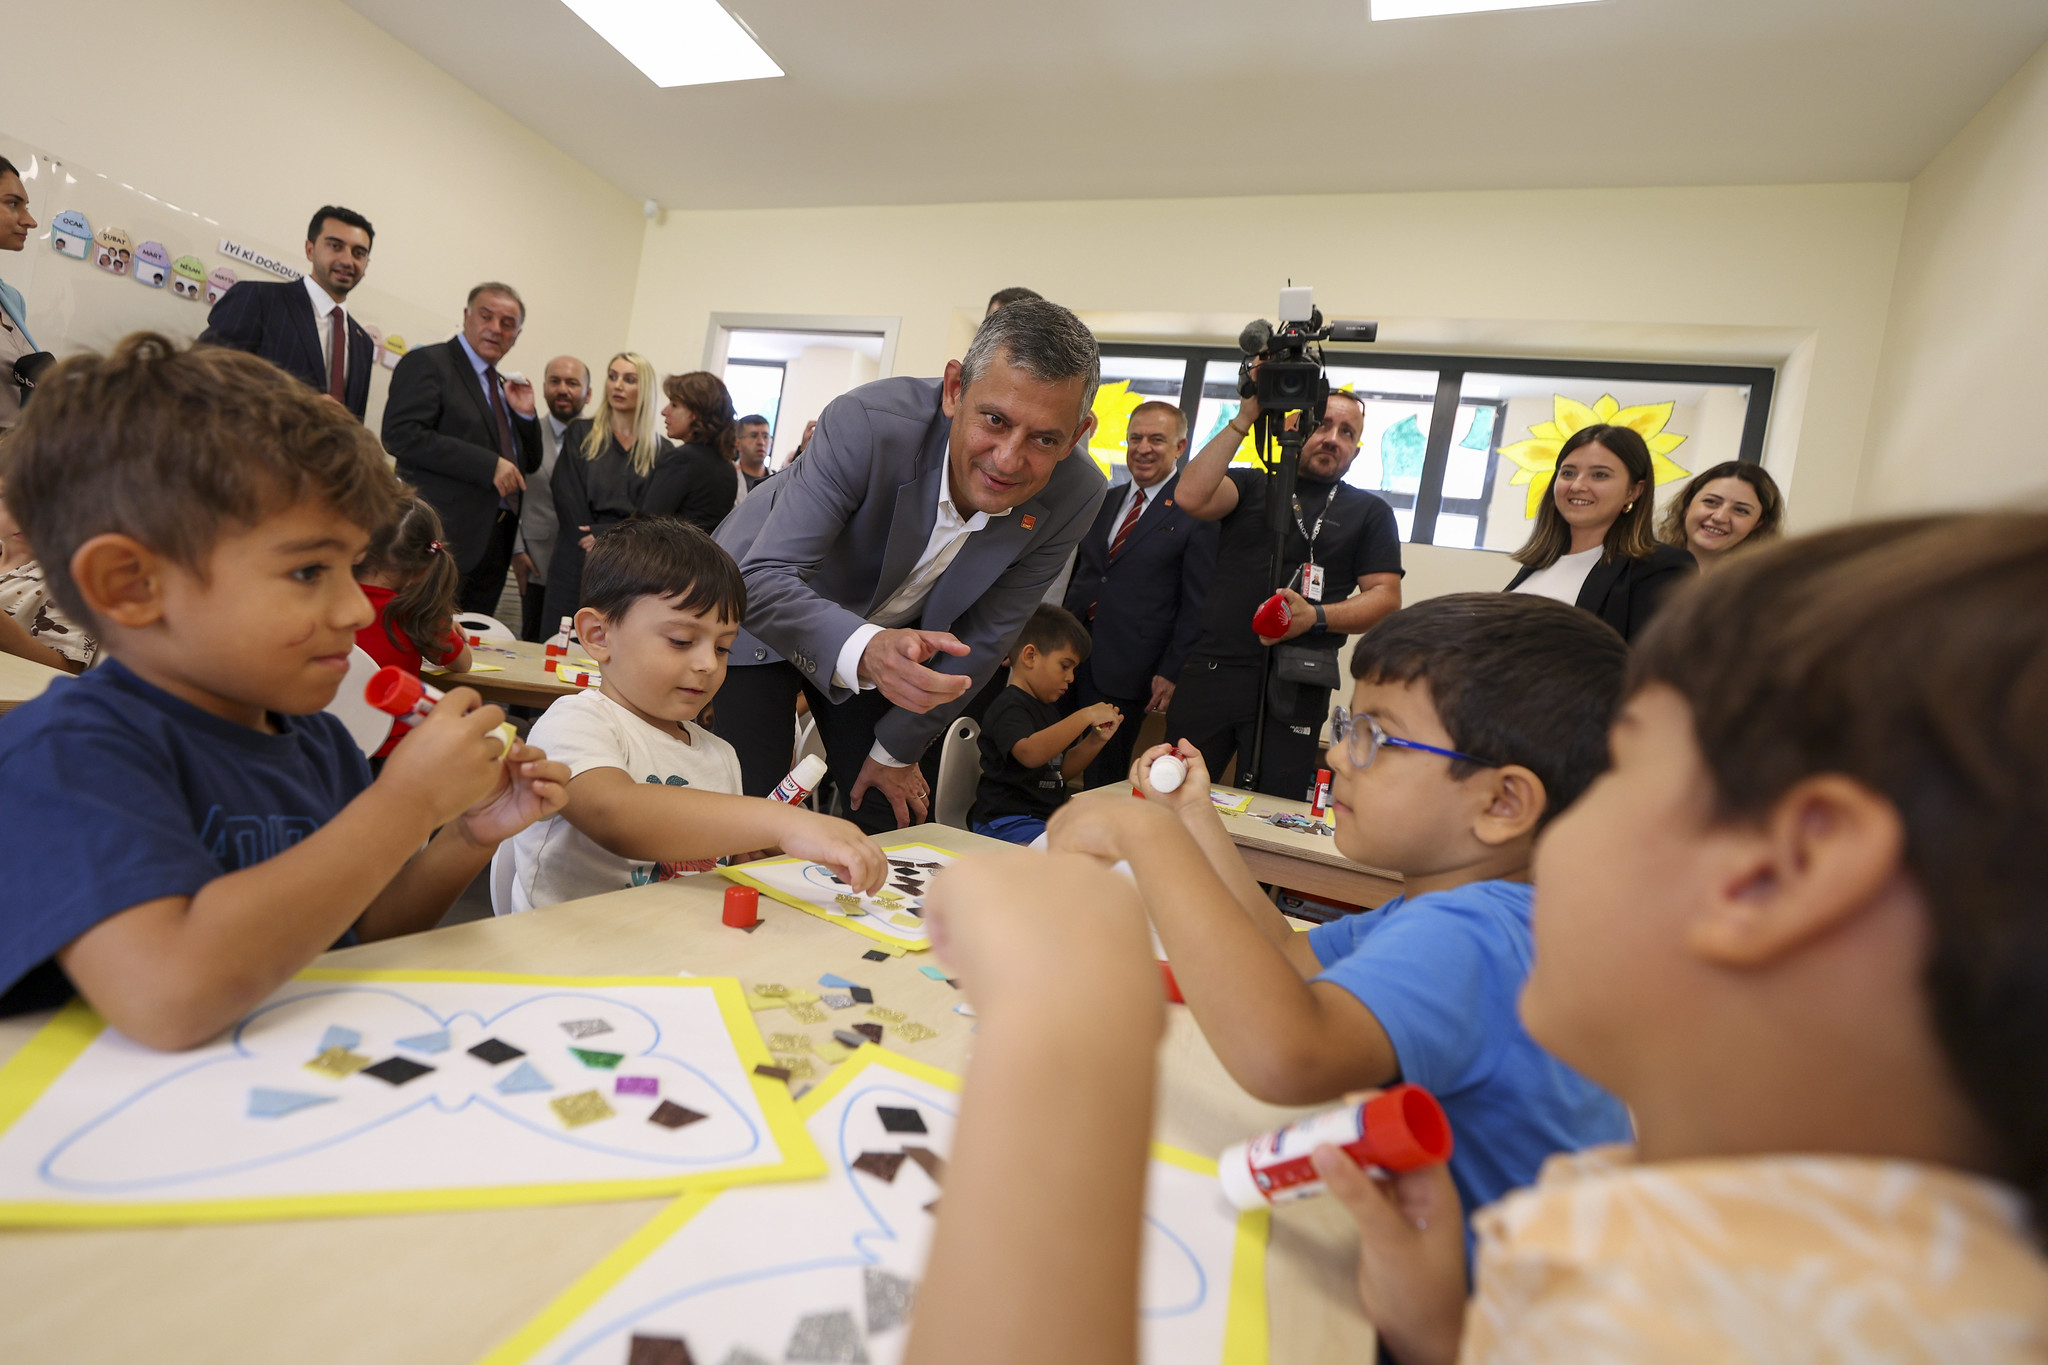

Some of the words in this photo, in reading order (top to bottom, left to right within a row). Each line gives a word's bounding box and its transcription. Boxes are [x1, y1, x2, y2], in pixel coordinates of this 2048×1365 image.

[62, 217, 84, 230] OCAK
[103, 233, 126, 246] ŞUBAT
[142, 249, 162, 260] MART
[224, 241, 241, 256] İYİ
[241, 249, 255, 261] Kİ
[180, 263, 201, 275] NİSAN
[1297, 518, 1310, 541] SONY
[1311, 518, 1323, 541] SONY
